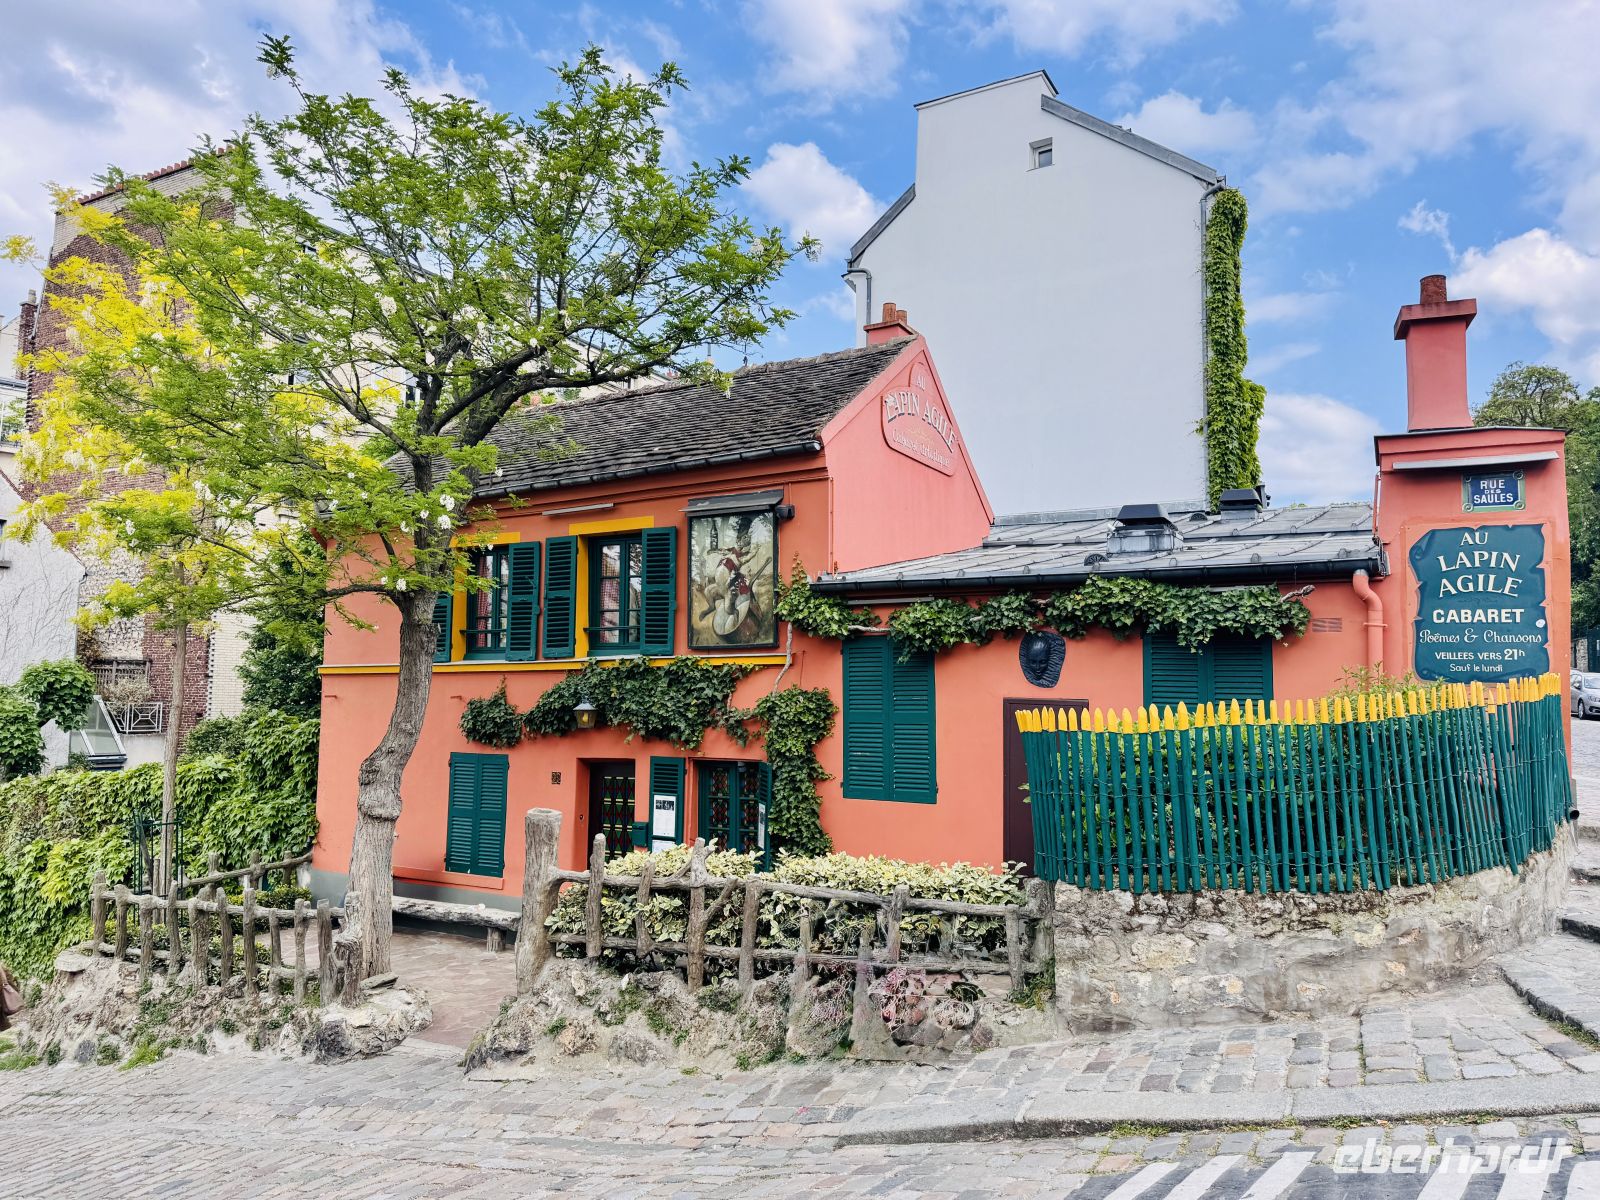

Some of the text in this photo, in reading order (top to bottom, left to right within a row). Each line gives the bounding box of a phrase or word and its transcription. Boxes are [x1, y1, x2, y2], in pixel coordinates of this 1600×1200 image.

[885, 391, 956, 453] LAPIN AGILE
[1480, 479, 1506, 489] RUE
[1473, 493, 1514, 504] SAULES
[1460, 532, 1489, 546] AU
[1436, 550, 1521, 573] LAPIN
[1438, 573, 1523, 598] AGILE
[1432, 608, 1525, 624] CABARET
[1463, 627, 1479, 643] &
[1483, 629, 1542, 644] Chansons
[1434, 651, 1475, 660] VEILLEES
[1477, 651, 1502, 660] VERS
[1449, 663, 1503, 672] Sauf le lundi
